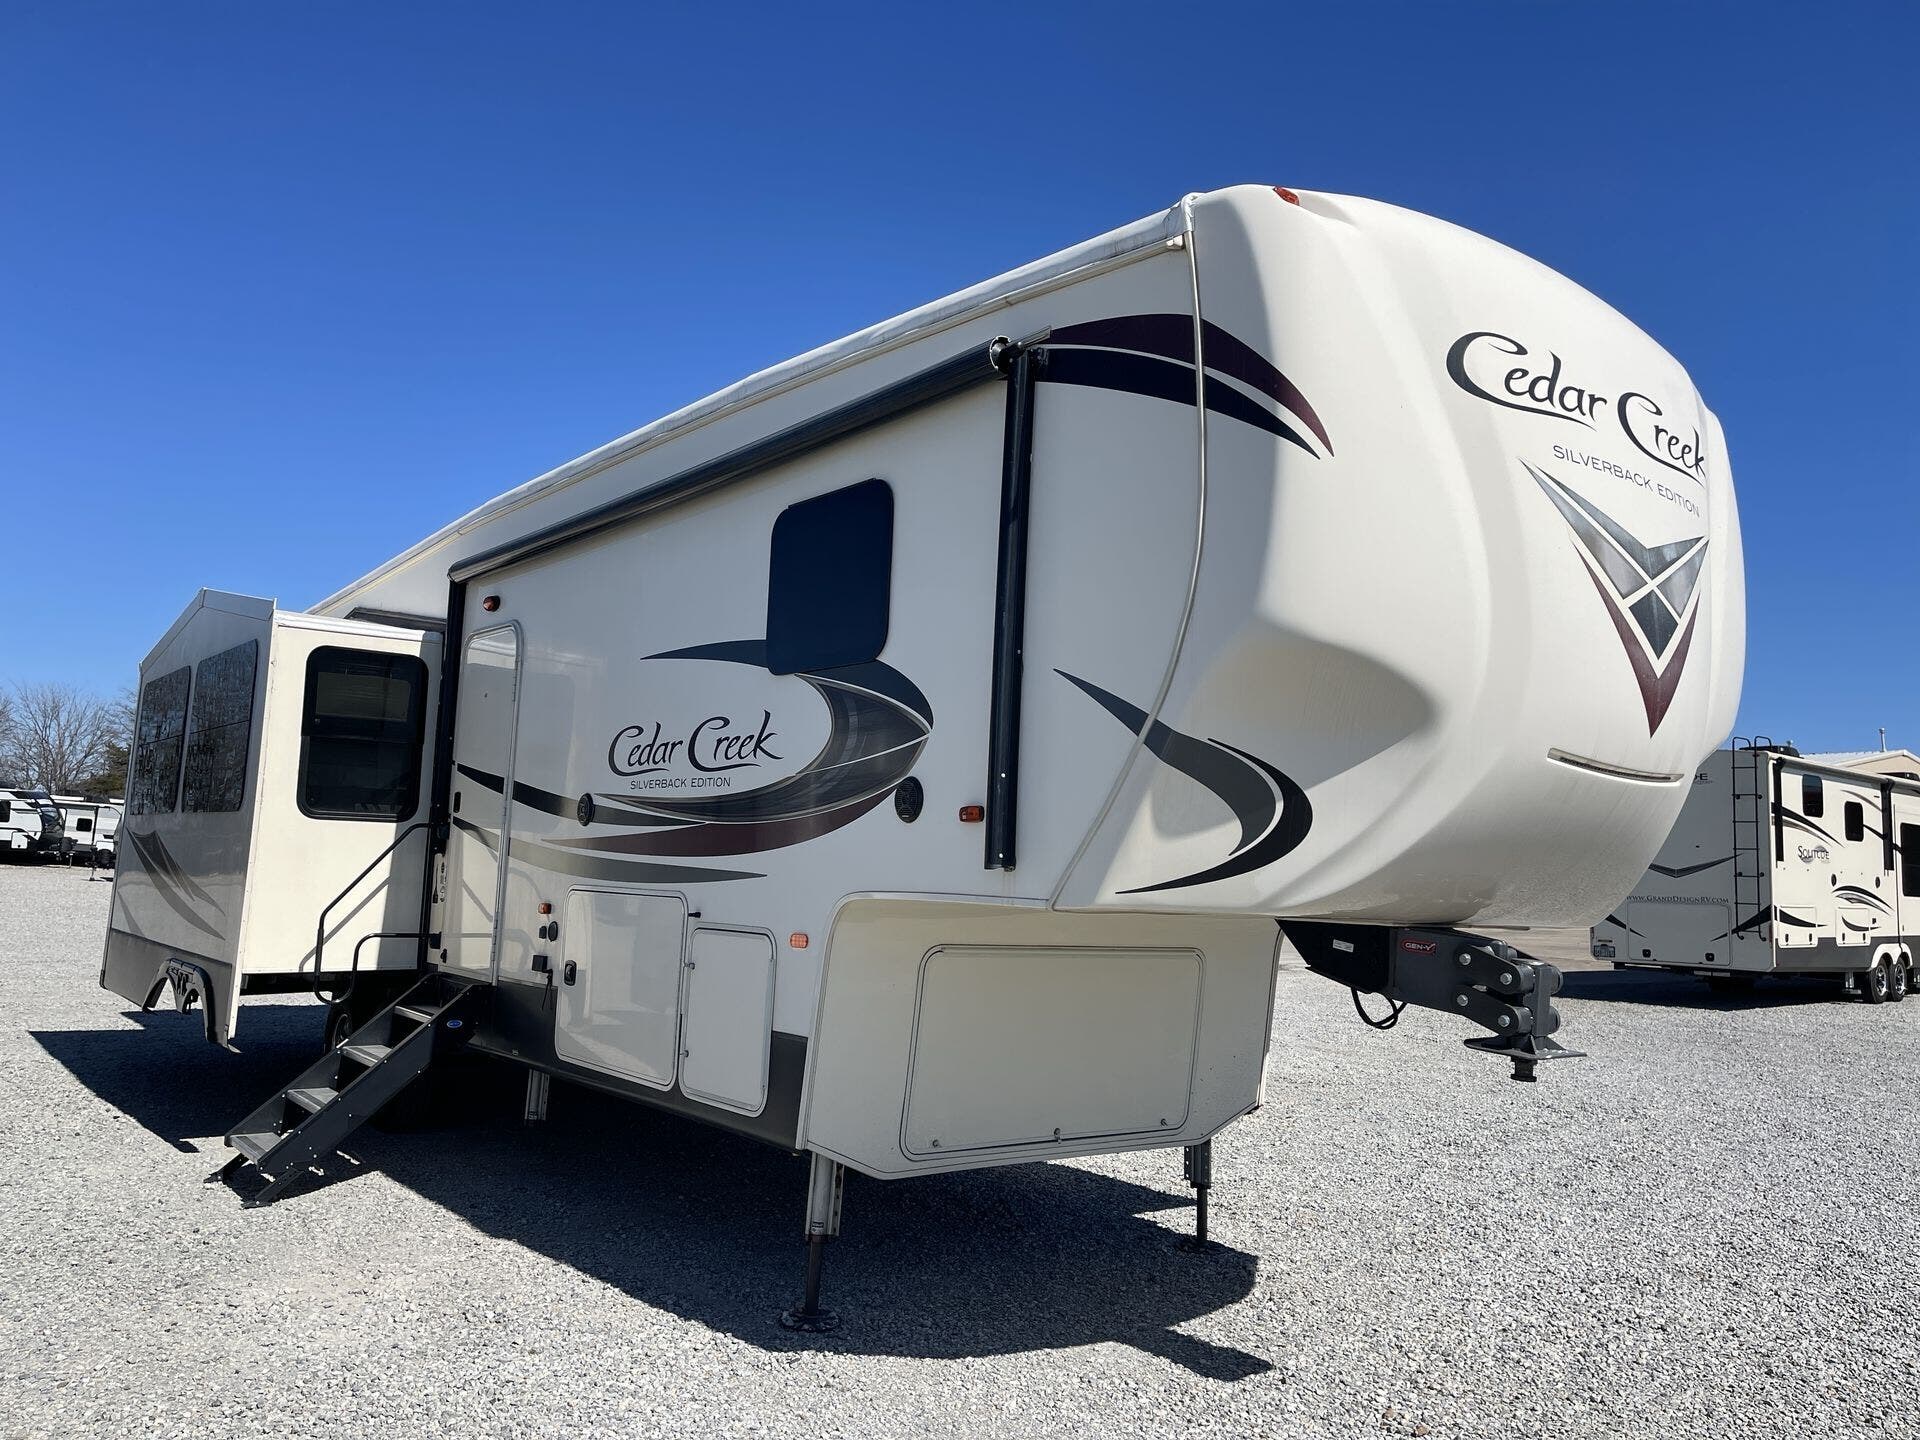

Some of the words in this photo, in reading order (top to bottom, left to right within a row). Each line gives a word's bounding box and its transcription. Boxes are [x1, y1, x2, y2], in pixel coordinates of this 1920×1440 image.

[1446, 331, 1608, 432] Cedar
[1617, 391, 1706, 488] Creek
[1553, 445, 1653, 492] SILVERBACK
[1657, 484, 1700, 518] EDITION
[608, 721, 684, 777] Cedar
[688, 709, 785, 773] Creek
[630, 778, 687, 790] SILVERBACK
[690, 777, 731, 788] EDITION
